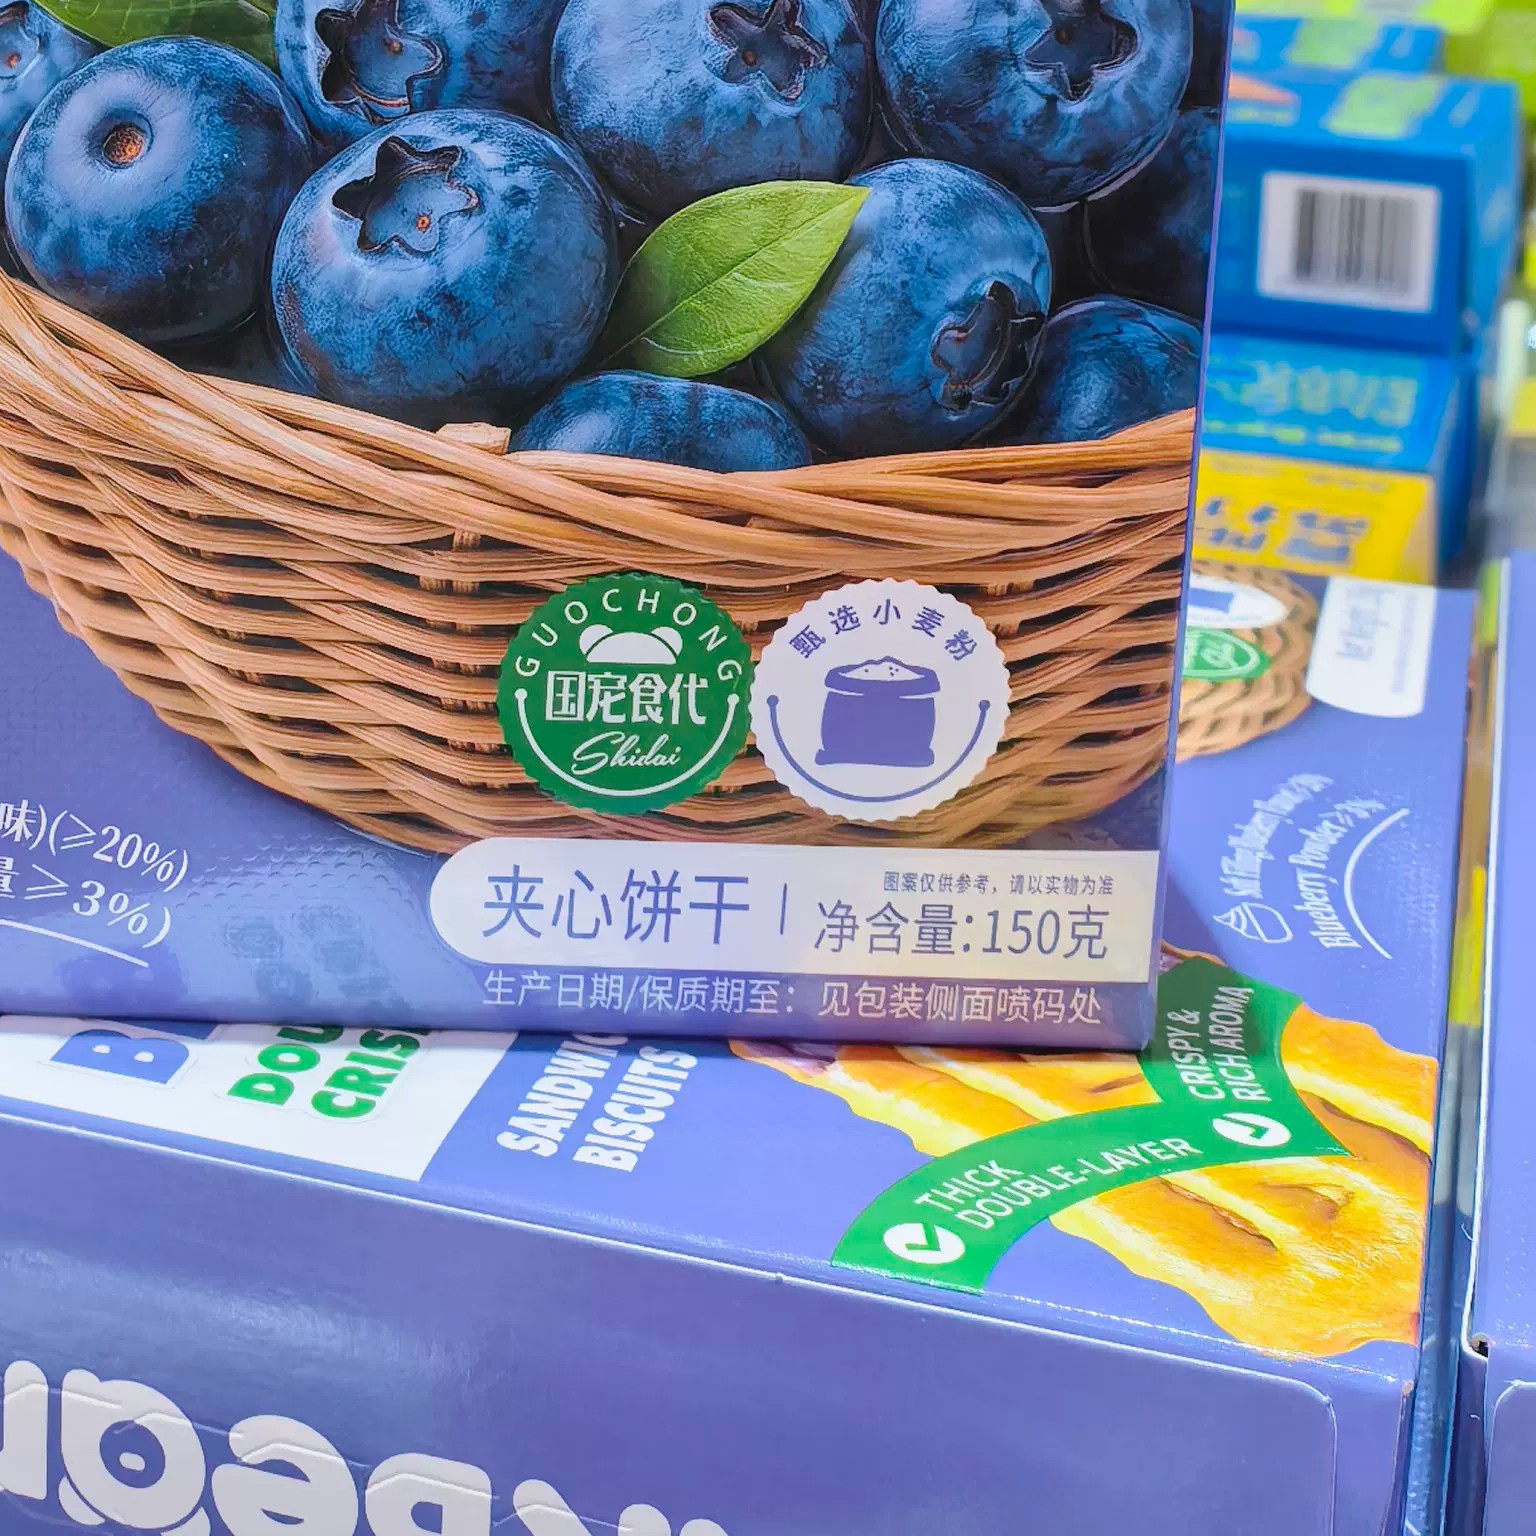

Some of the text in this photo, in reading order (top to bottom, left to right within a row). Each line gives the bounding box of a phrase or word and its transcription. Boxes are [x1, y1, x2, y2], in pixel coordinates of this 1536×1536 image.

[515, 587, 743, 682] GUOCHONG
[788, 598, 982, 662] 甄选小麦粉
[545, 670, 708, 726] 国宠食代
[571, 730, 681, 775] Shidai
[481, 863, 750, 946] 夹心饼干
[311, 1026, 430, 1118] CRIS
[1166, 1009, 1225, 1099] CRISPY &
[1208, 985, 1272, 1101] RICH AROMA
[572, 1046, 698, 1173] BISCUITS
[914, 1159, 1025, 1213] THICK
[954, 1137, 1204, 1230] DOUBLE-LAYER
